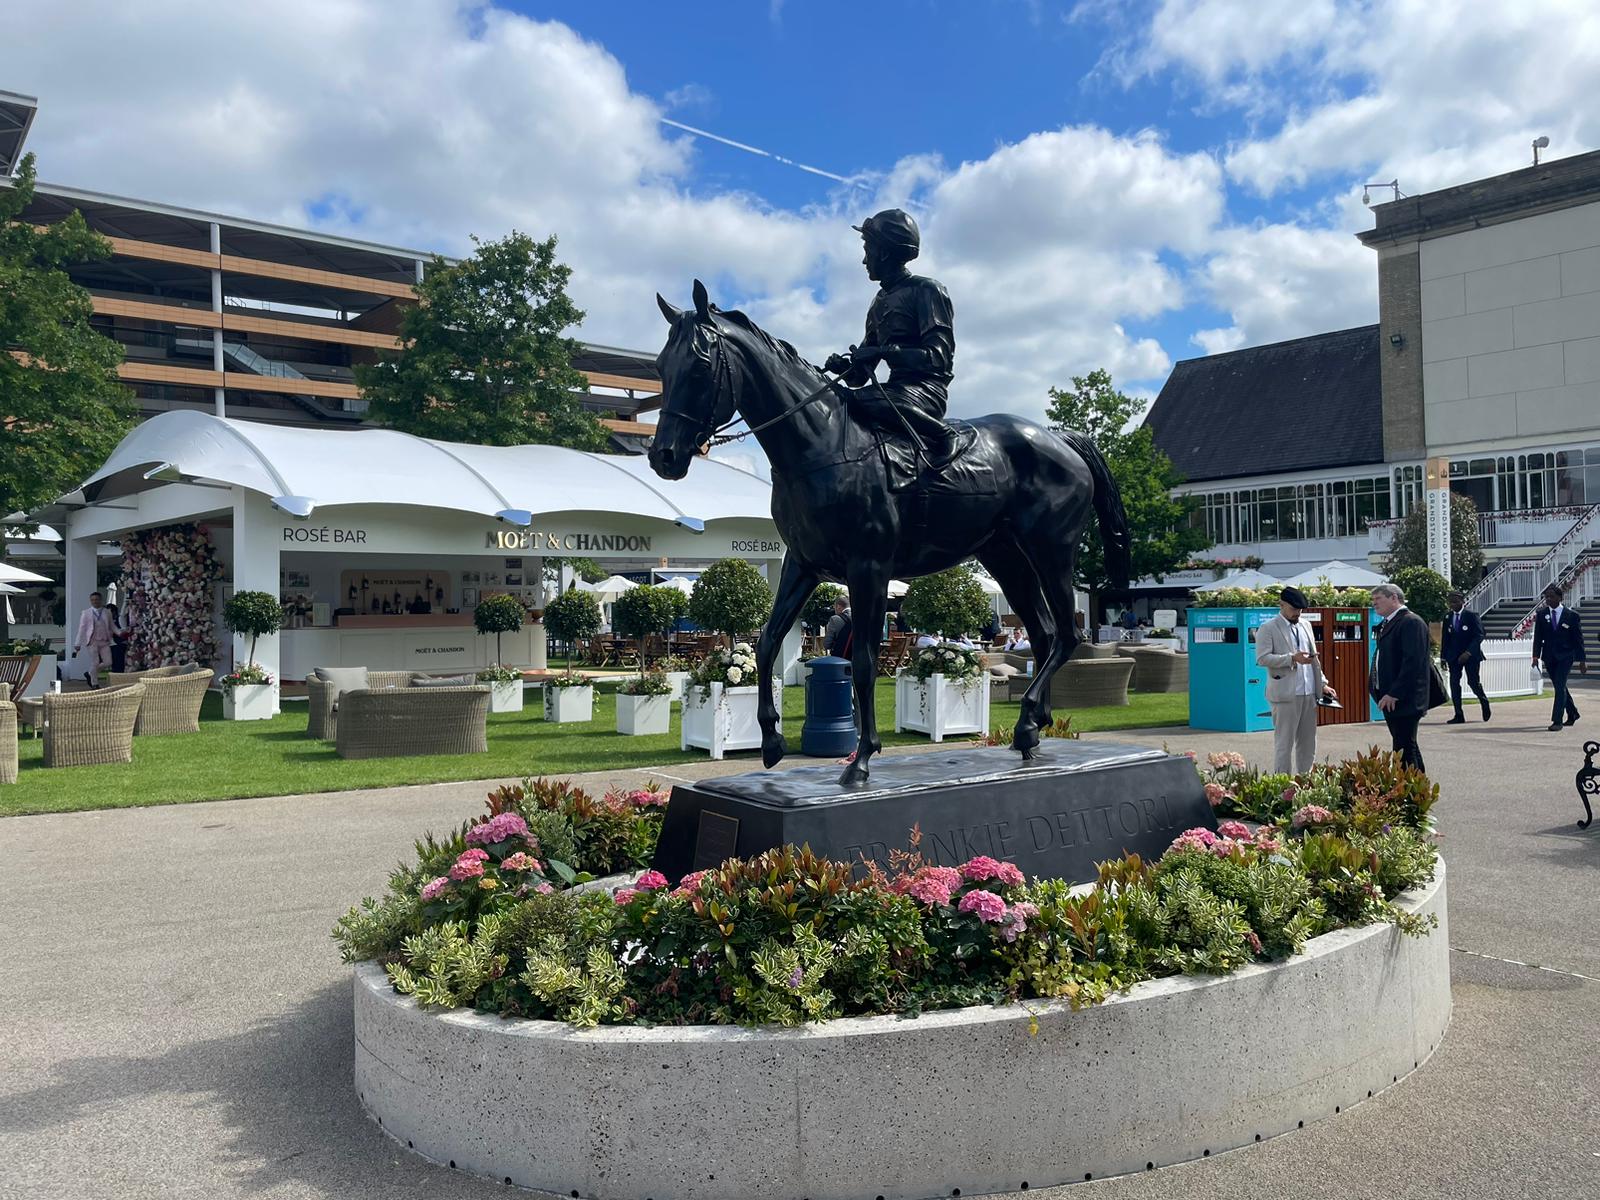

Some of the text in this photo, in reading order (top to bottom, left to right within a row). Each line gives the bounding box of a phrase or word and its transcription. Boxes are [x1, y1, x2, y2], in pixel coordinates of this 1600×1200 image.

[283, 526, 366, 543] ROSÉ BAR
[485, 529, 652, 551] MOËT & CHANDON
[731, 539, 780, 552] ROSÉ BAR
[1026, 796, 1176, 853] DETTORI
